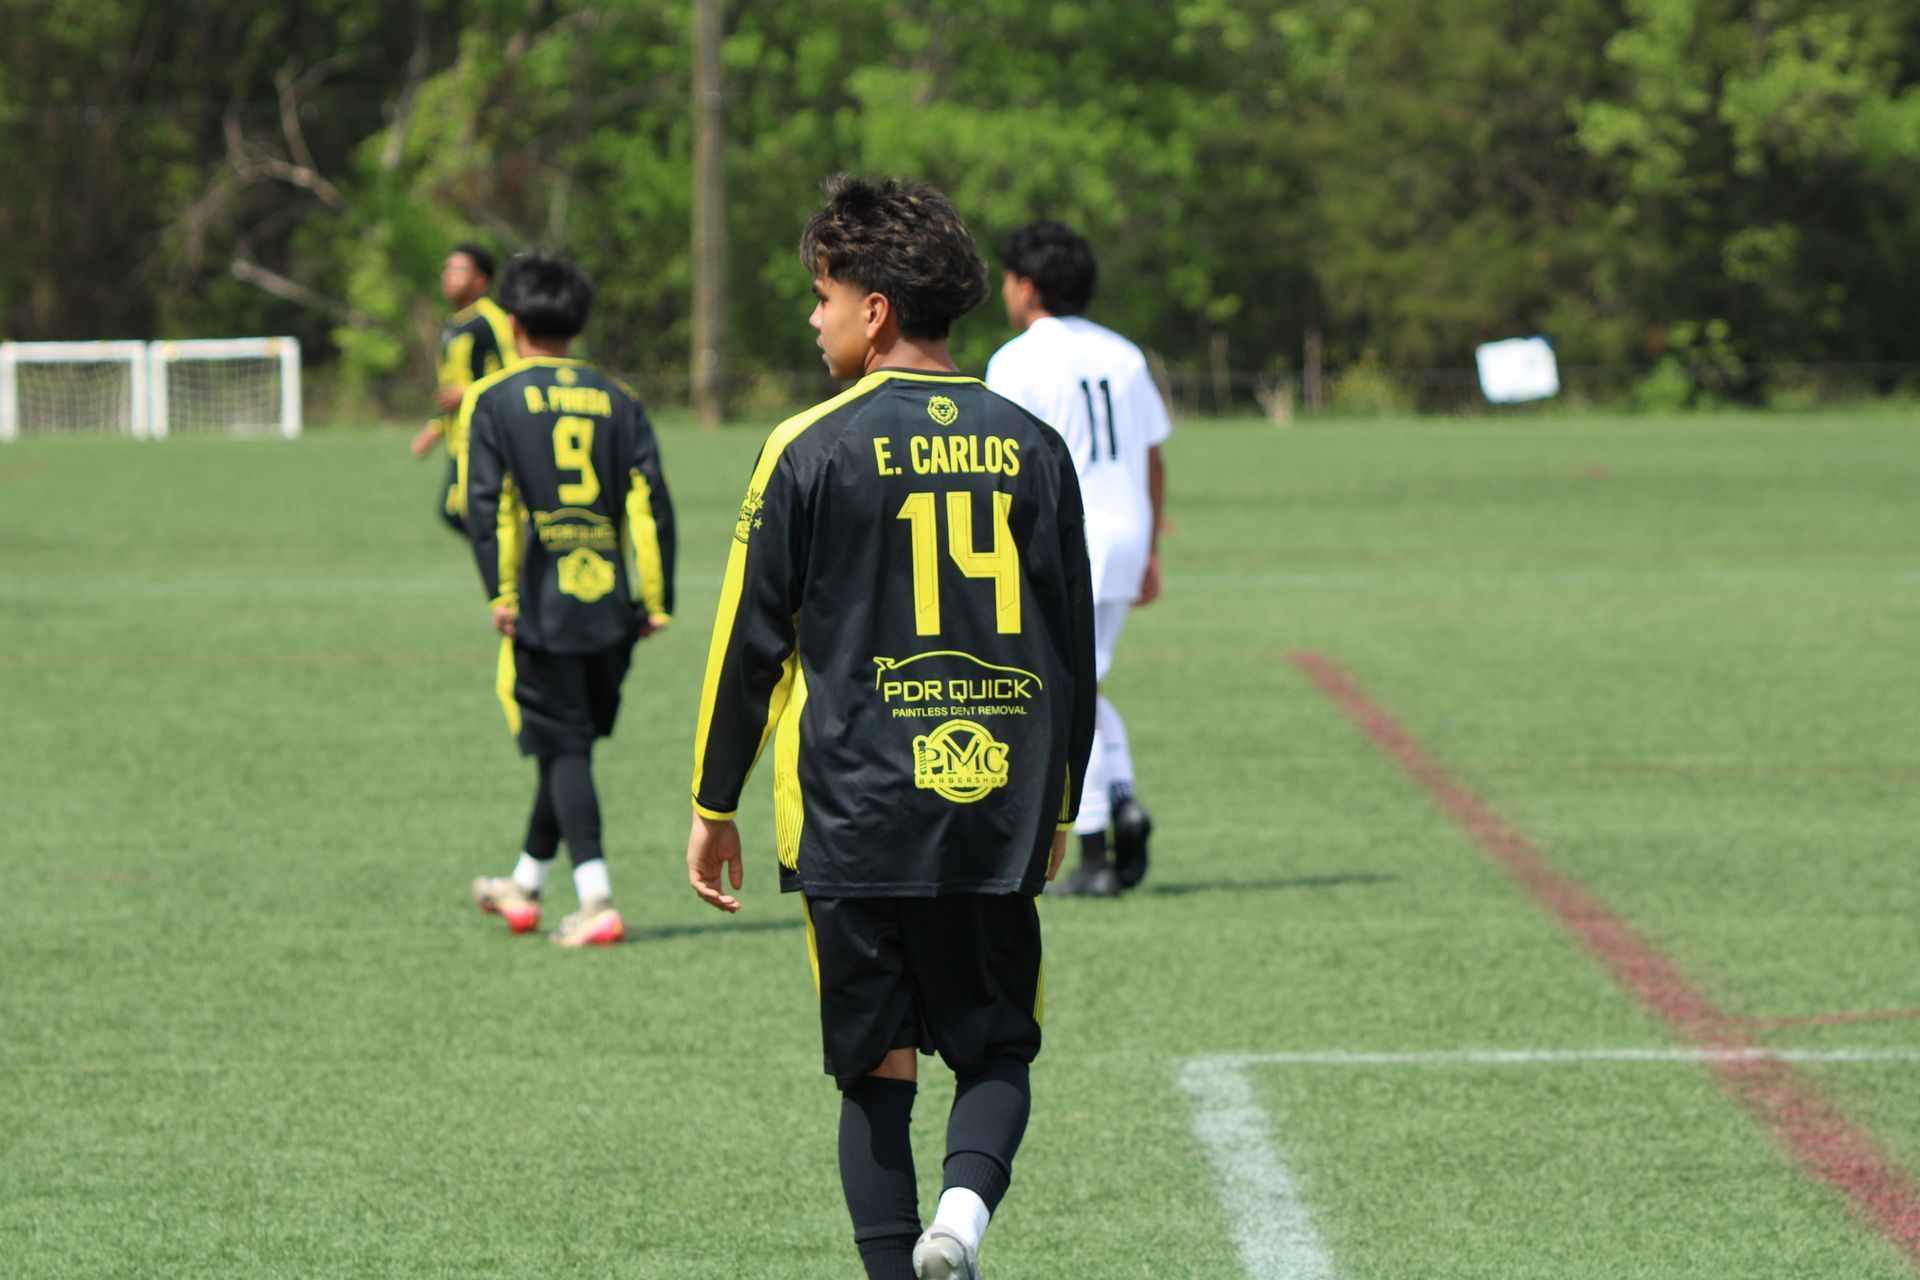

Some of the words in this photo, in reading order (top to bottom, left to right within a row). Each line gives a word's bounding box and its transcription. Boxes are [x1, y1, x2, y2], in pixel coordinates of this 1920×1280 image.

[1081, 379, 1117, 462] 11
[552, 416, 600, 505] 9
[873, 437, 902, 476] E.
[910, 435, 1020, 477] CARLOS
[896, 491, 1021, 636] 14
[884, 680, 943, 702] PDR
[949, 679, 1032, 703] QUICK
[892, 706, 948, 718] PAINTLESS
[950, 706, 975, 717] DENT
[978, 705, 1027, 716] REMOVAL
[917, 738, 1004, 775] PMC
[918, 776, 1006, 786] BARBERSHOP
